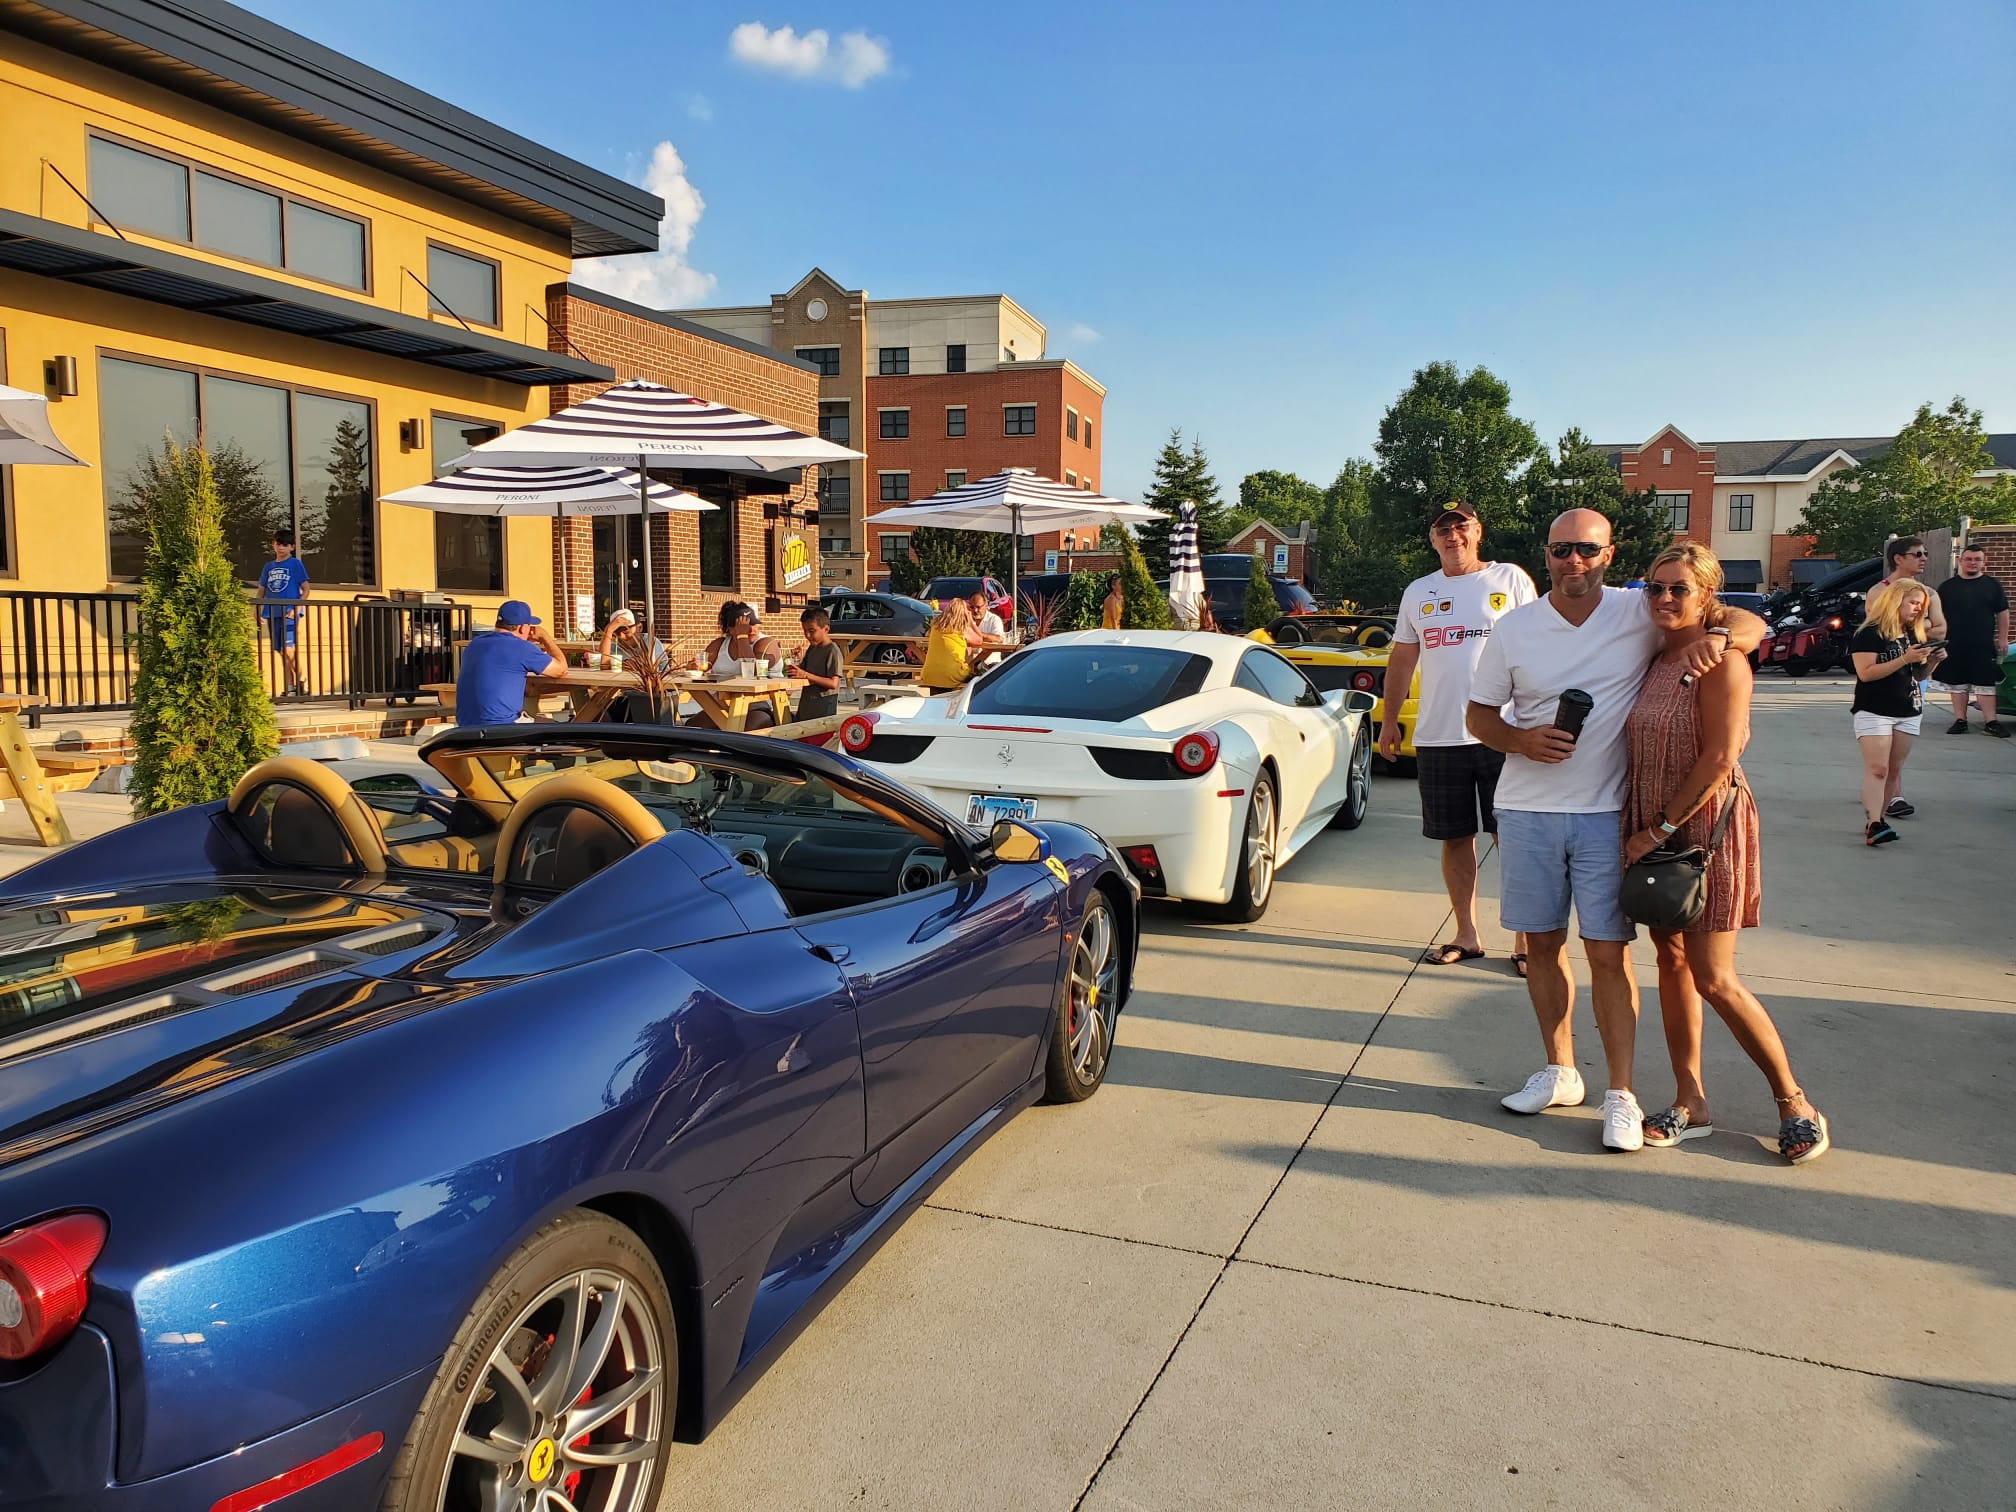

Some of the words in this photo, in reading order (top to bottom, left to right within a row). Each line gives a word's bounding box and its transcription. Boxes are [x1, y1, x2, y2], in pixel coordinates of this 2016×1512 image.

[638, 442, 704, 451] PERONI
[1448, 629, 1491, 640] YEARS
[454, 1289, 516, 1395] Continental
